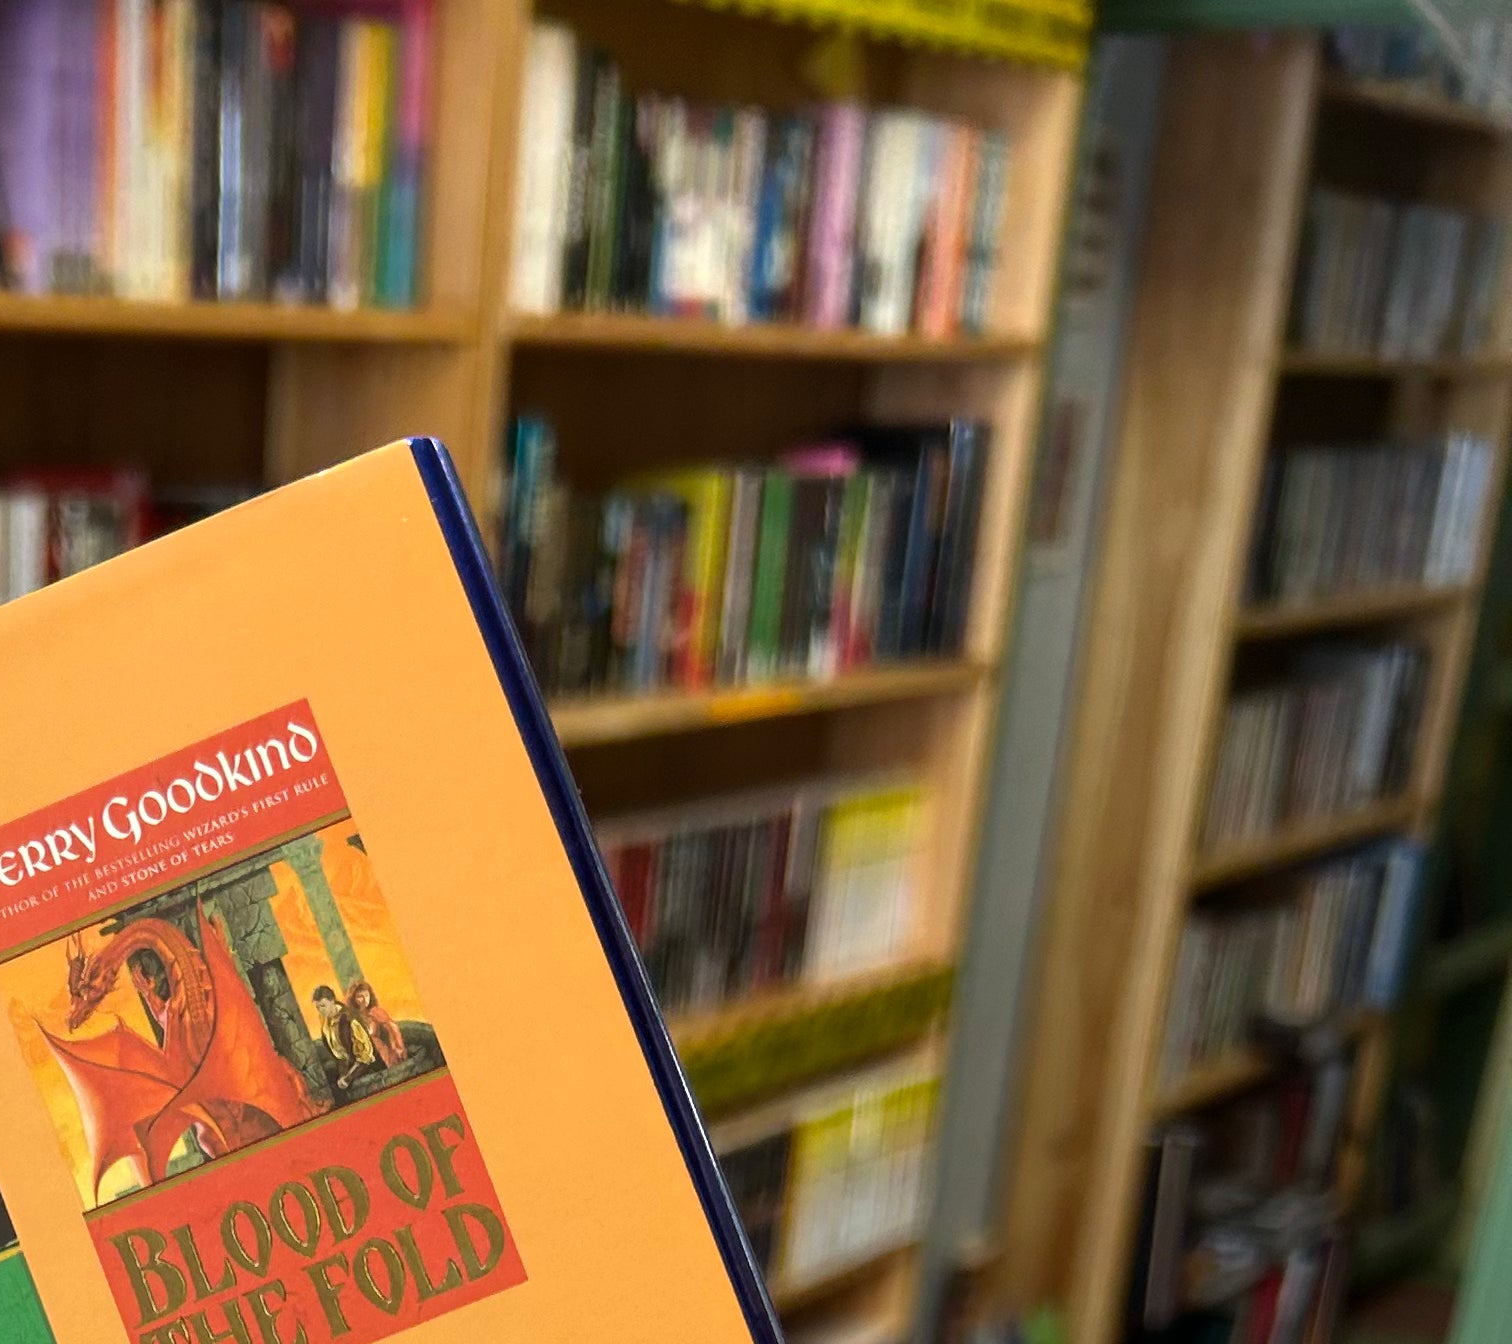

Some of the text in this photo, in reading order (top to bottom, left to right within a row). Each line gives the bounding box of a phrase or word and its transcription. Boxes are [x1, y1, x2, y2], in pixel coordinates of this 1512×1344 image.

[42, 886, 59, 902] OF
[64, 874, 90, 892] THE
[94, 835, 180, 879] BESTSELLING
[183, 807, 249, 841] WIZARD'S
[252, 788, 289, 813] FIRST
[293, 772, 329, 796] RULE
[89, 832, 234, 902] AND STONE OF TEARS
[109, 1112, 466, 1329] BLOOD OF
[304, 1203, 506, 1340] FOLD
